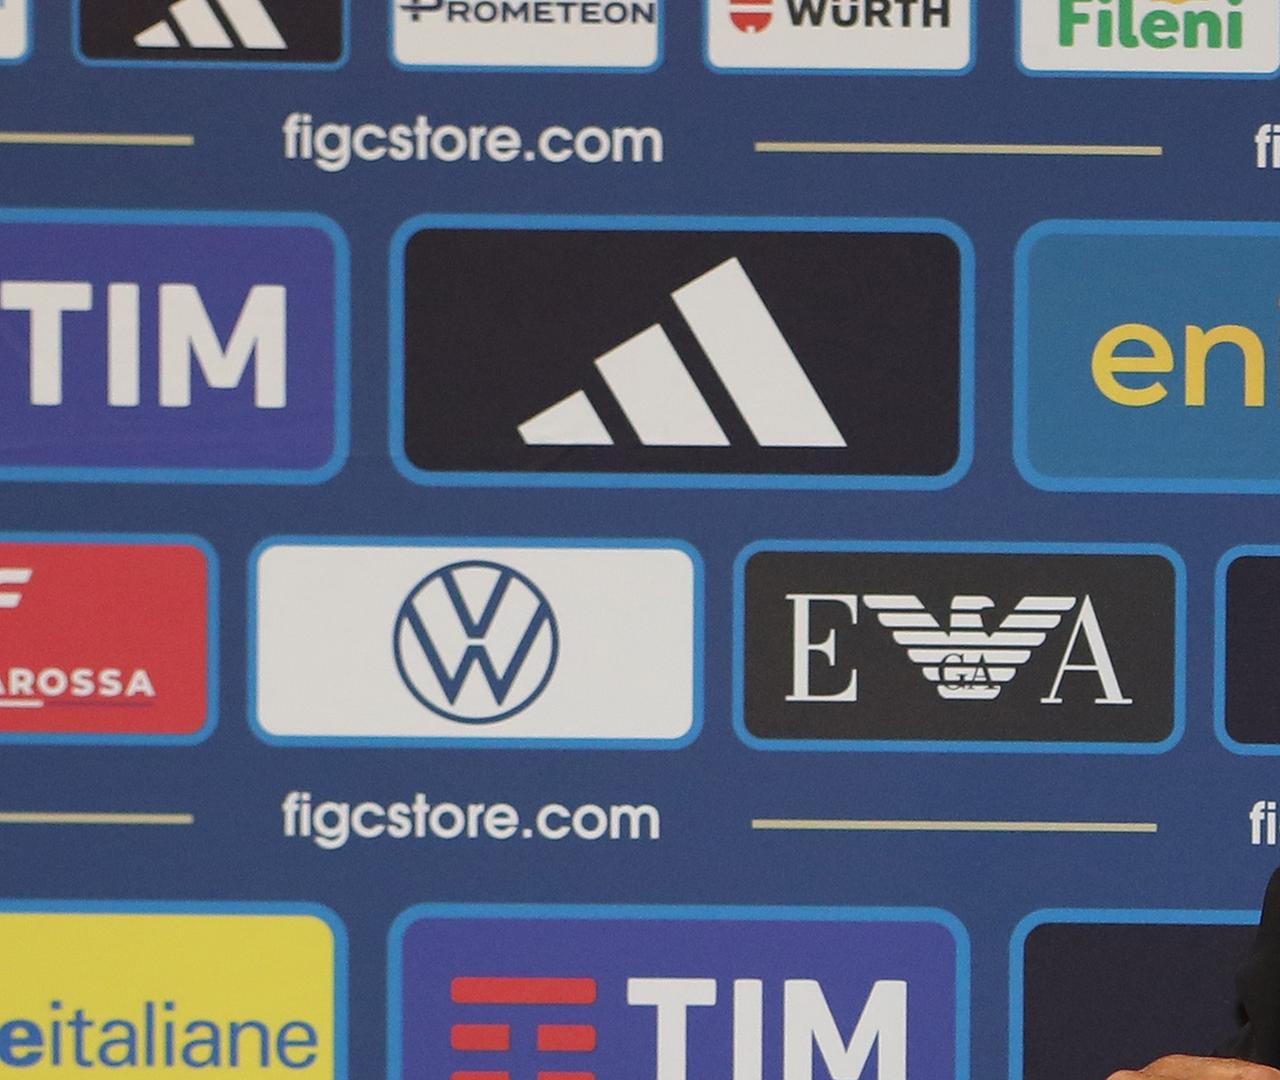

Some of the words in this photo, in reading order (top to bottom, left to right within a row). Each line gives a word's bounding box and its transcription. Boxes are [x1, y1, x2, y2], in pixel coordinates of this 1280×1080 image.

[1060, 0, 1243, 50] Fileni
[284, 114, 663, 172] figcstore.com
[0, 281, 287, 409] TIM
[284, 793, 660, 850] figcstore.com
